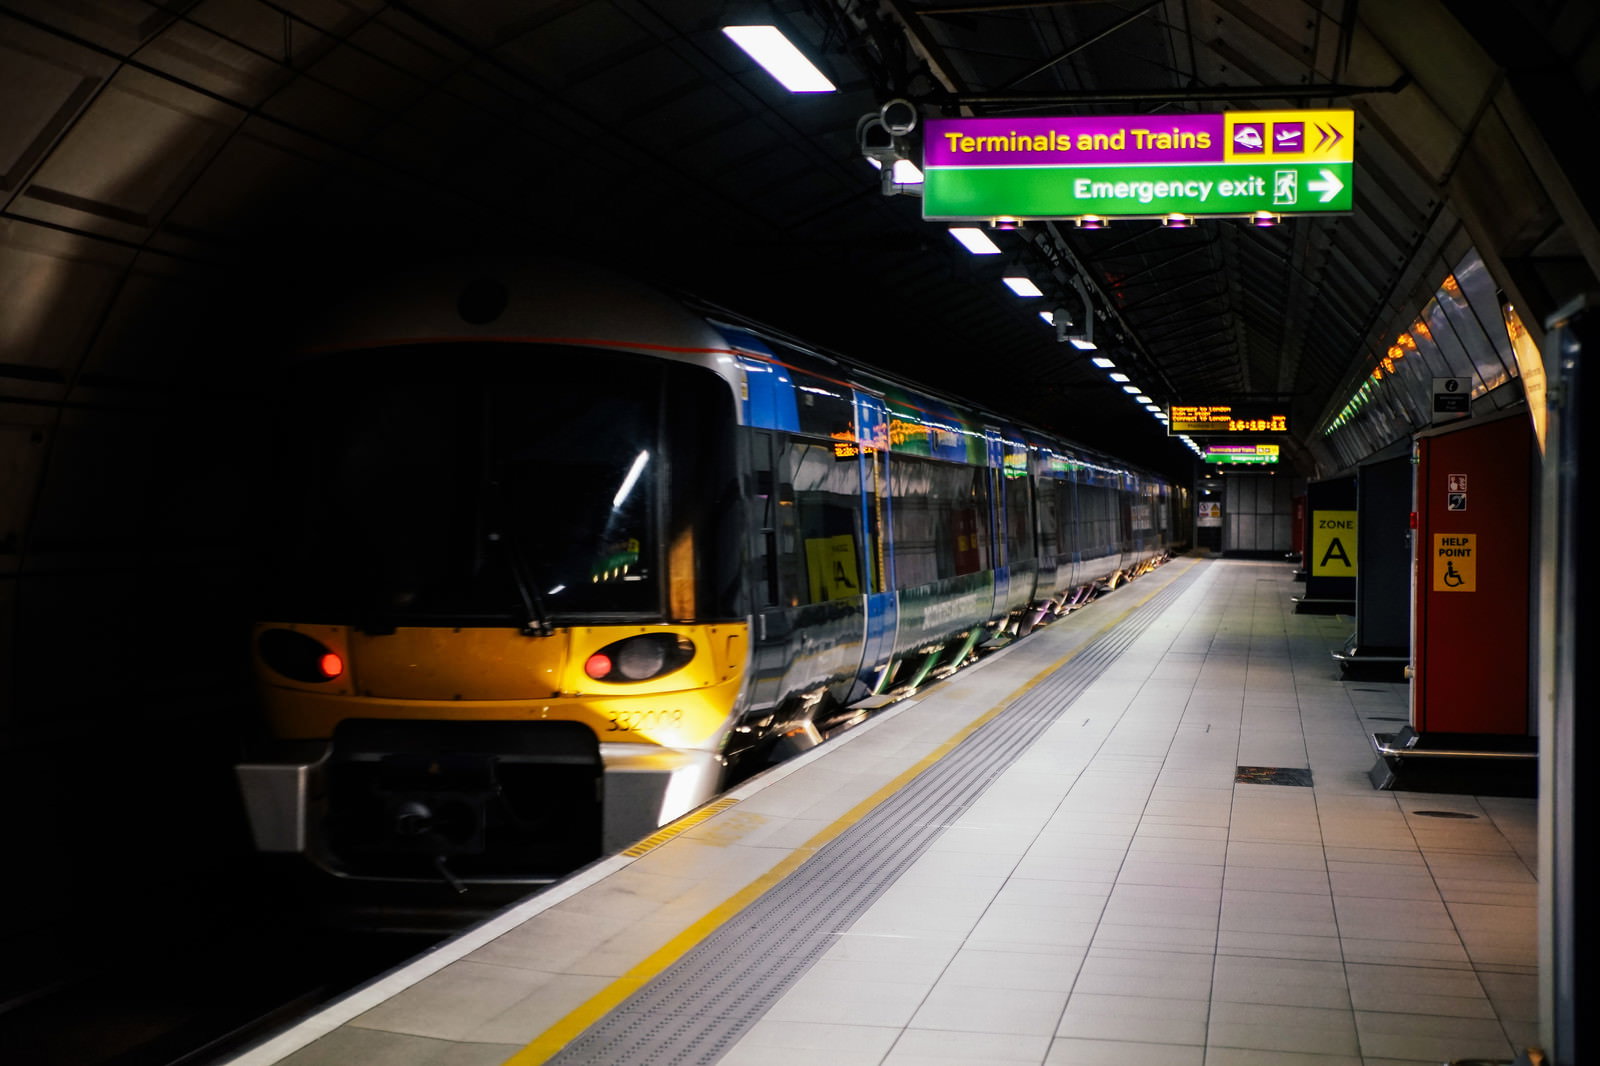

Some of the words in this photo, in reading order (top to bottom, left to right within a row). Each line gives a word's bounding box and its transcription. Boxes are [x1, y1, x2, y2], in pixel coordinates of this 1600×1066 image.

[944, 130, 1071, 153] Terminals
[1077, 129, 1125, 151] and
[1131, 127, 1212, 150] Trains
[1074, 179, 1214, 205] Emergency
[1218, 176, 1266, 197] exit
[1319, 520, 1354, 529] ZONE
[1442, 538, 1469, 546] HELP
[1320, 537, 1352, 567] A
[1439, 549, 1471, 557] POINT
